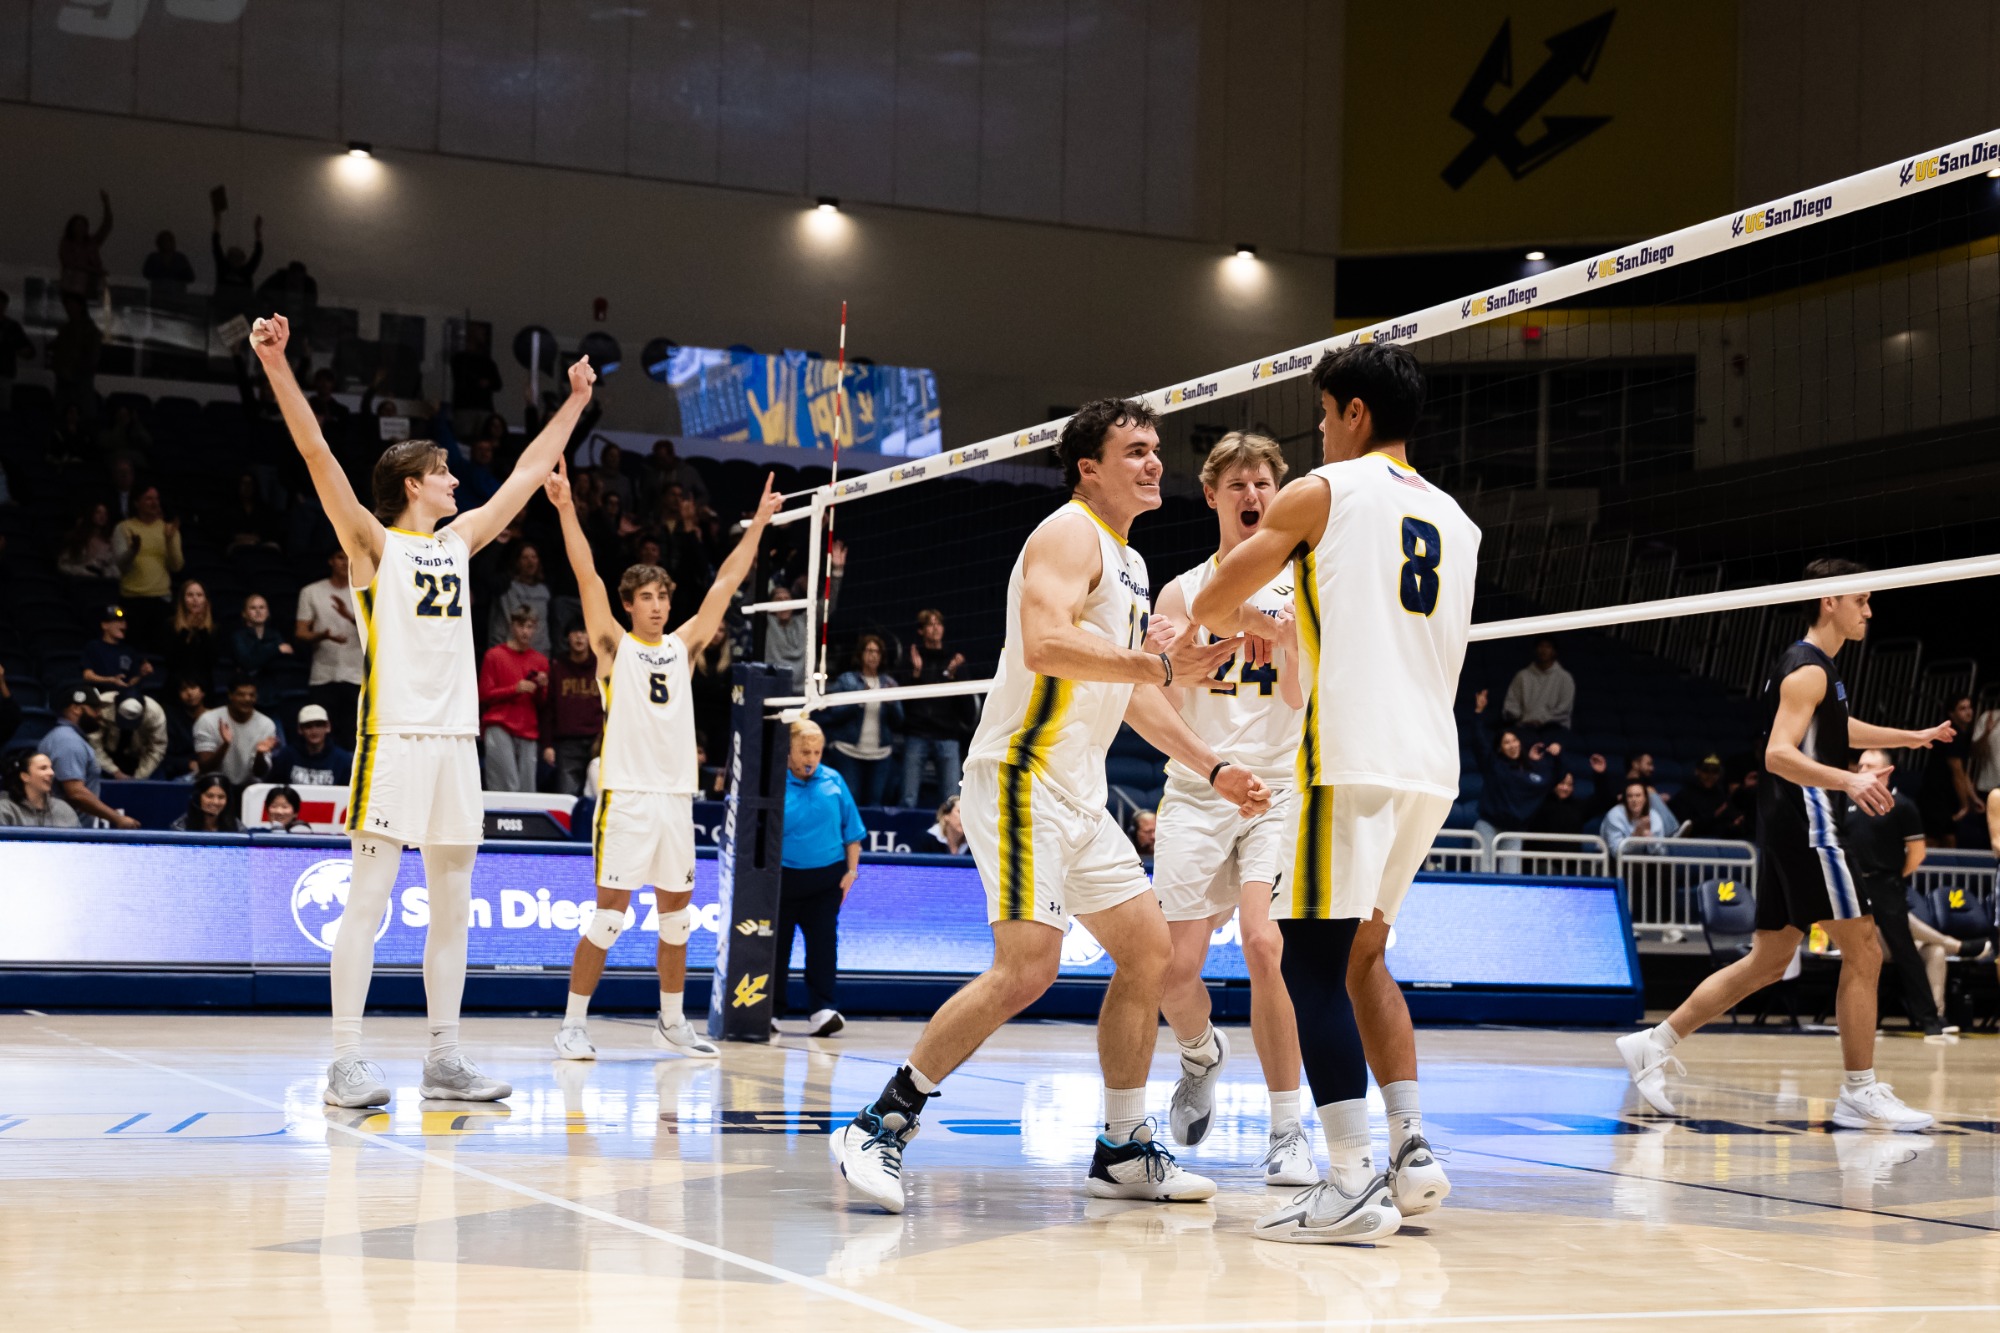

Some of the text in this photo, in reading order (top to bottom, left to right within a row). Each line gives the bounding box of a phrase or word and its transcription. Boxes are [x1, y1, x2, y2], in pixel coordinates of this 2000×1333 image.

[1915, 156, 1939, 182] UC
[1745, 210, 1765, 234] UC
[1599, 257, 1617, 278] UC
[1399, 515, 1442, 618] 8
[414, 570, 463, 618] 22
[1207, 632, 1279, 697] 24
[648, 672, 670, 705] 6
[401, 886, 492, 928] Sn
